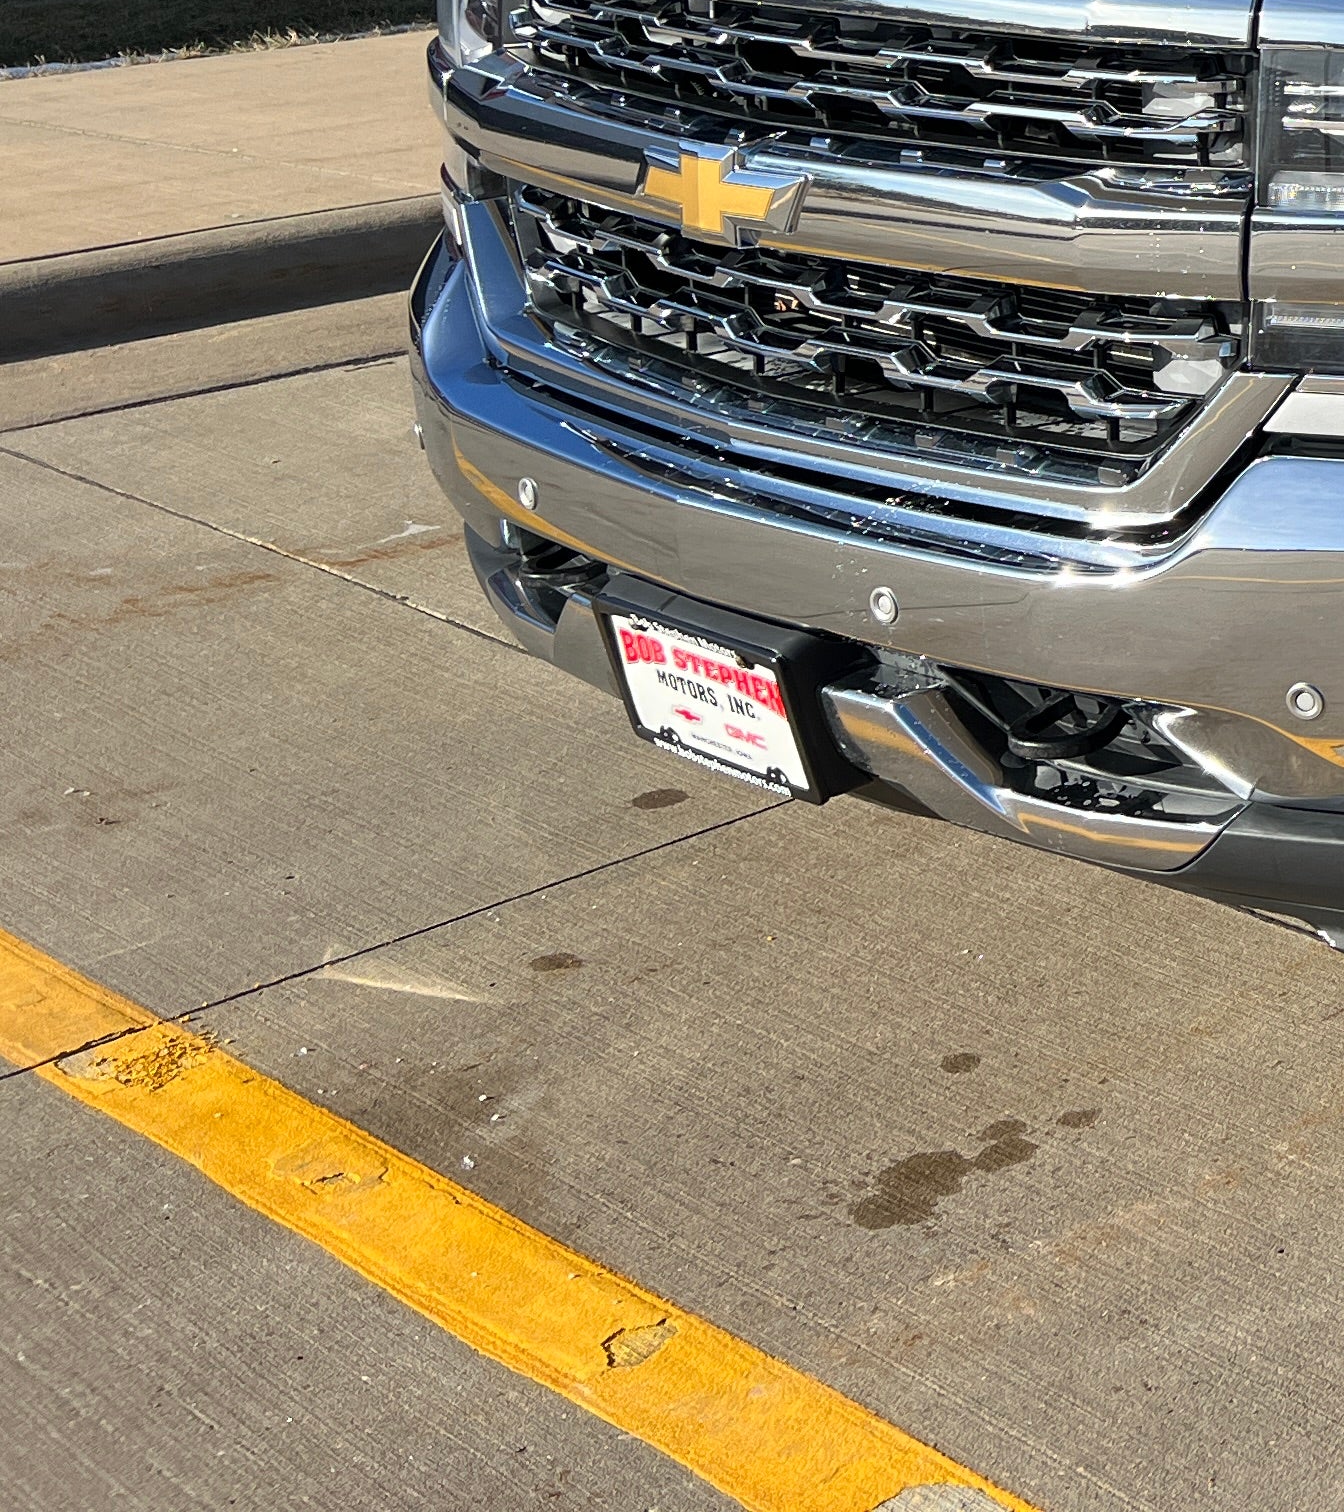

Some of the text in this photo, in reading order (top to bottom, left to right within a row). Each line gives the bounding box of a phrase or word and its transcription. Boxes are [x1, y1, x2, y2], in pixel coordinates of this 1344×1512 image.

[618, 627, 789, 722] BOB STEPHEN
[723, 723, 769, 751] GMC
